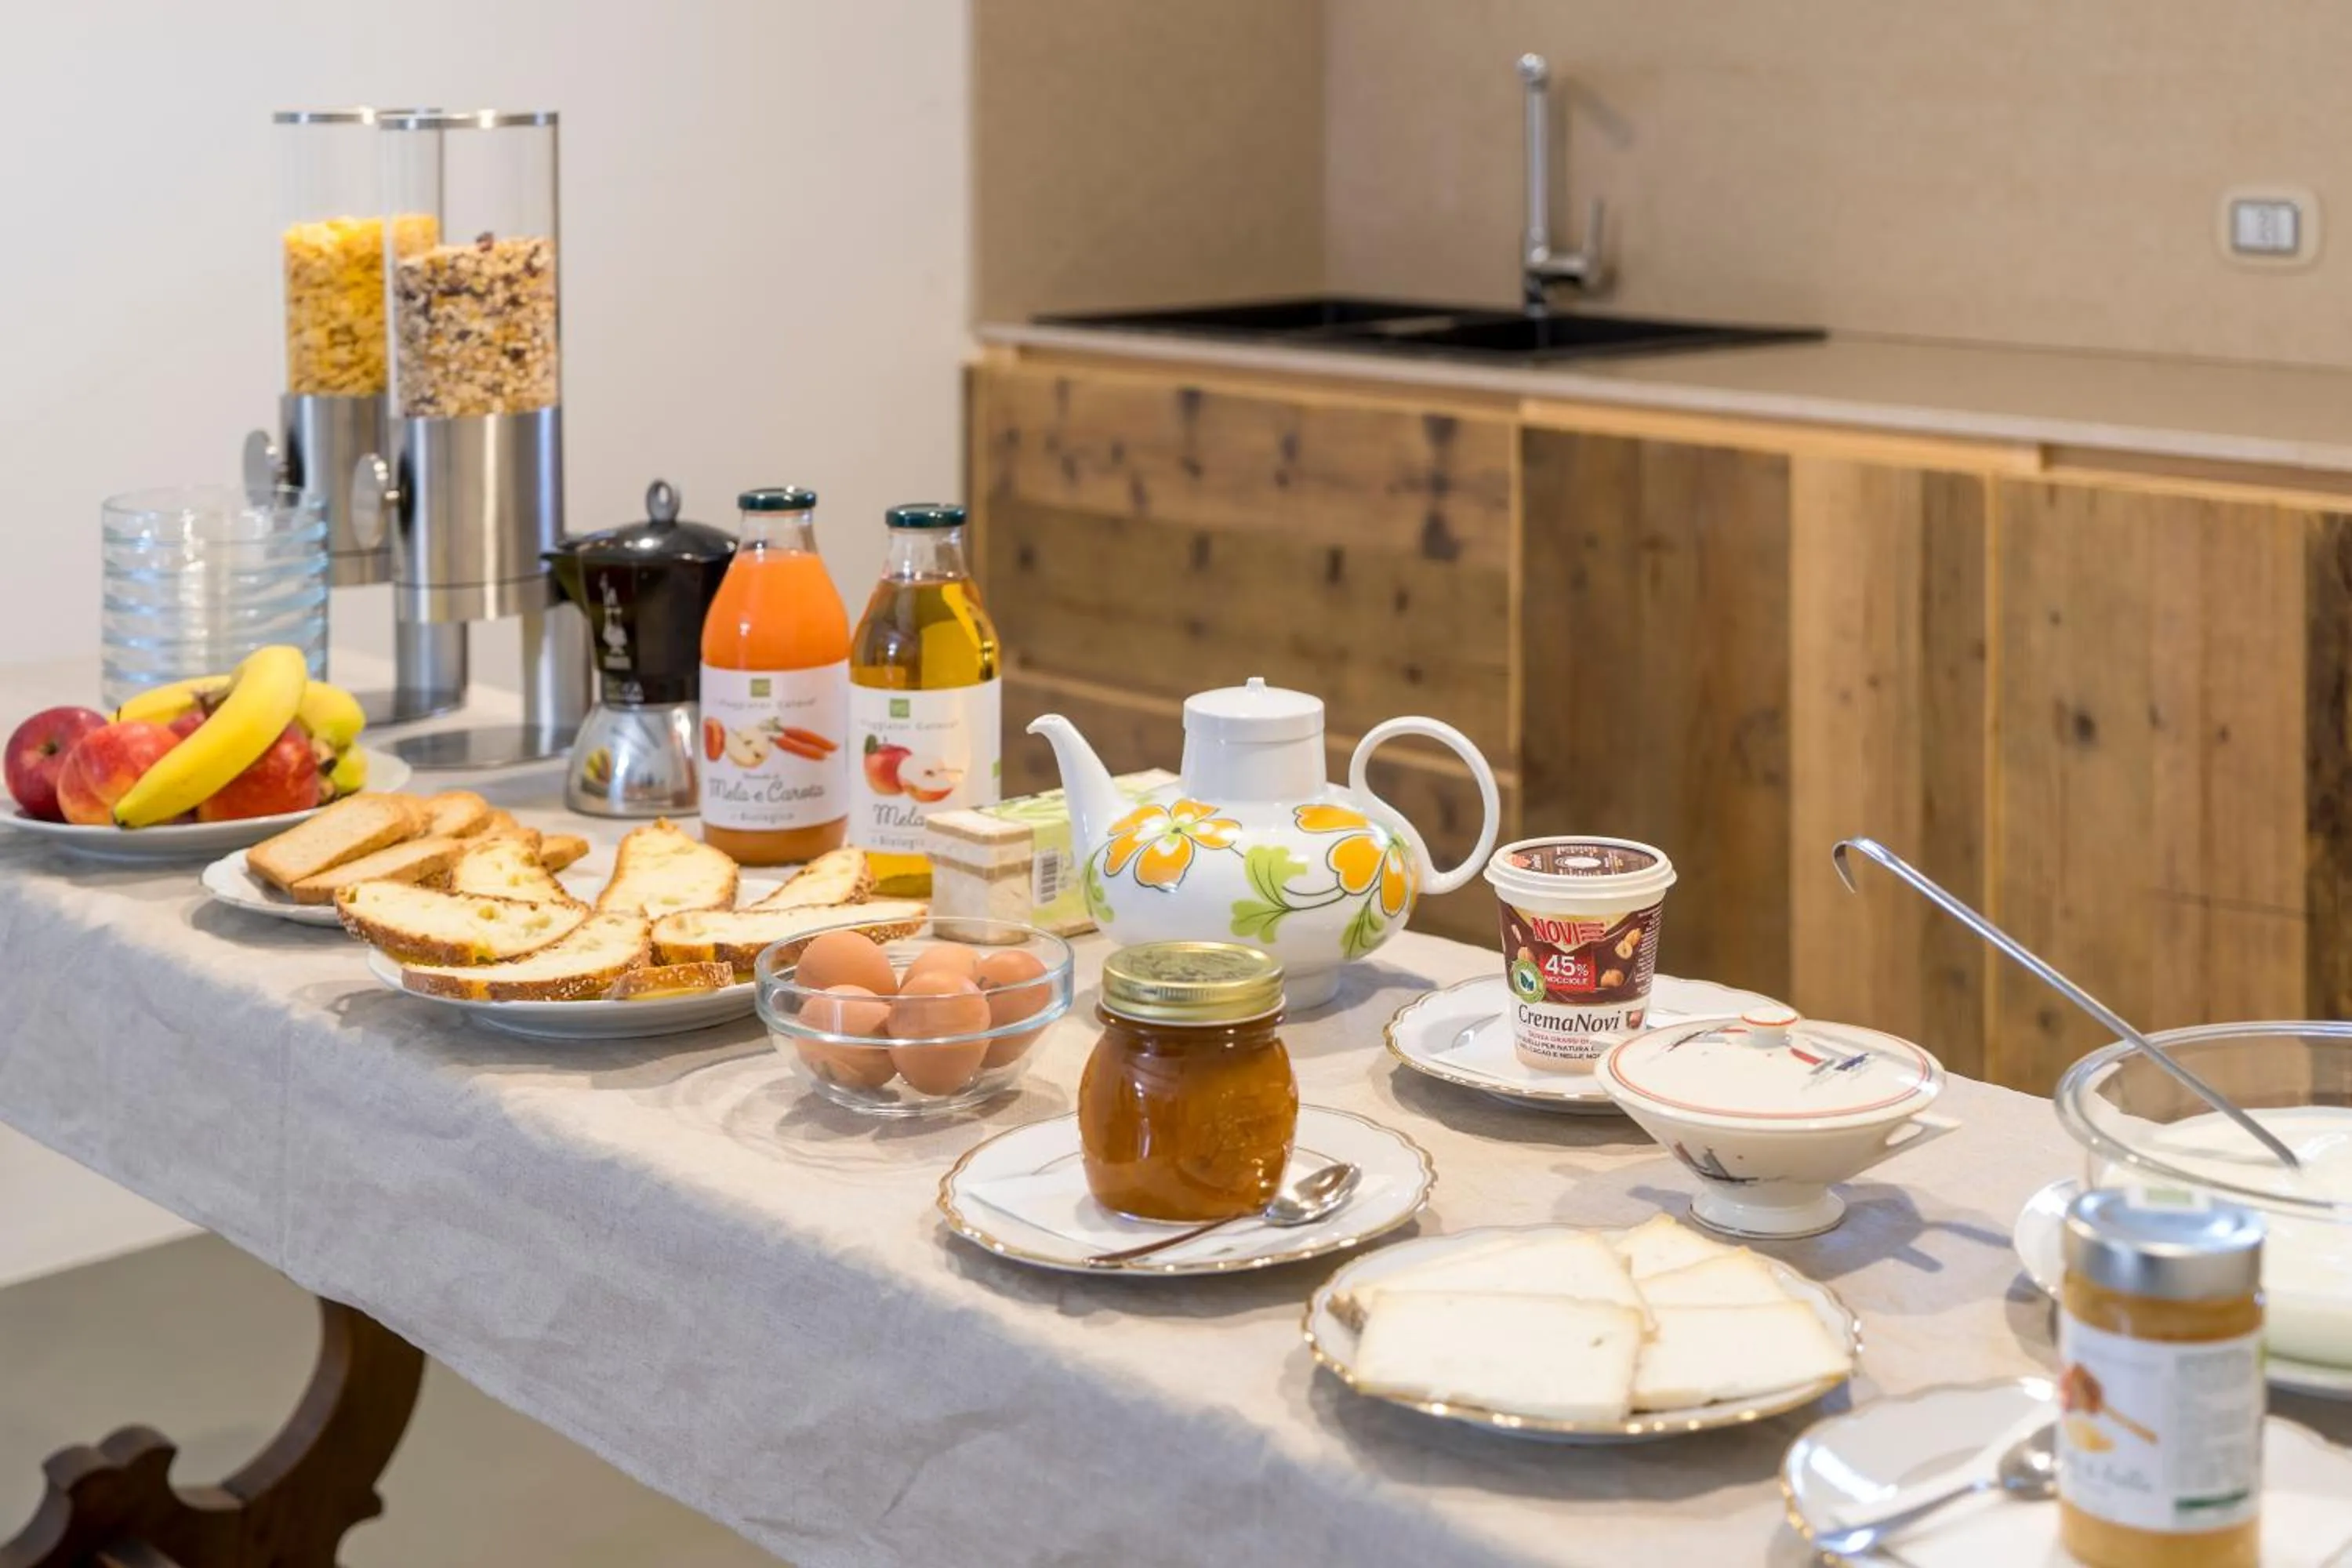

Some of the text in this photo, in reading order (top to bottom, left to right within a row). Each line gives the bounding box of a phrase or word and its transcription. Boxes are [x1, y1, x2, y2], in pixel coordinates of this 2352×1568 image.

[873, 804, 925, 827] Mela
[1531, 916, 1581, 945] NOVI
[1519, 1004, 1621, 1033] CremaNovi
